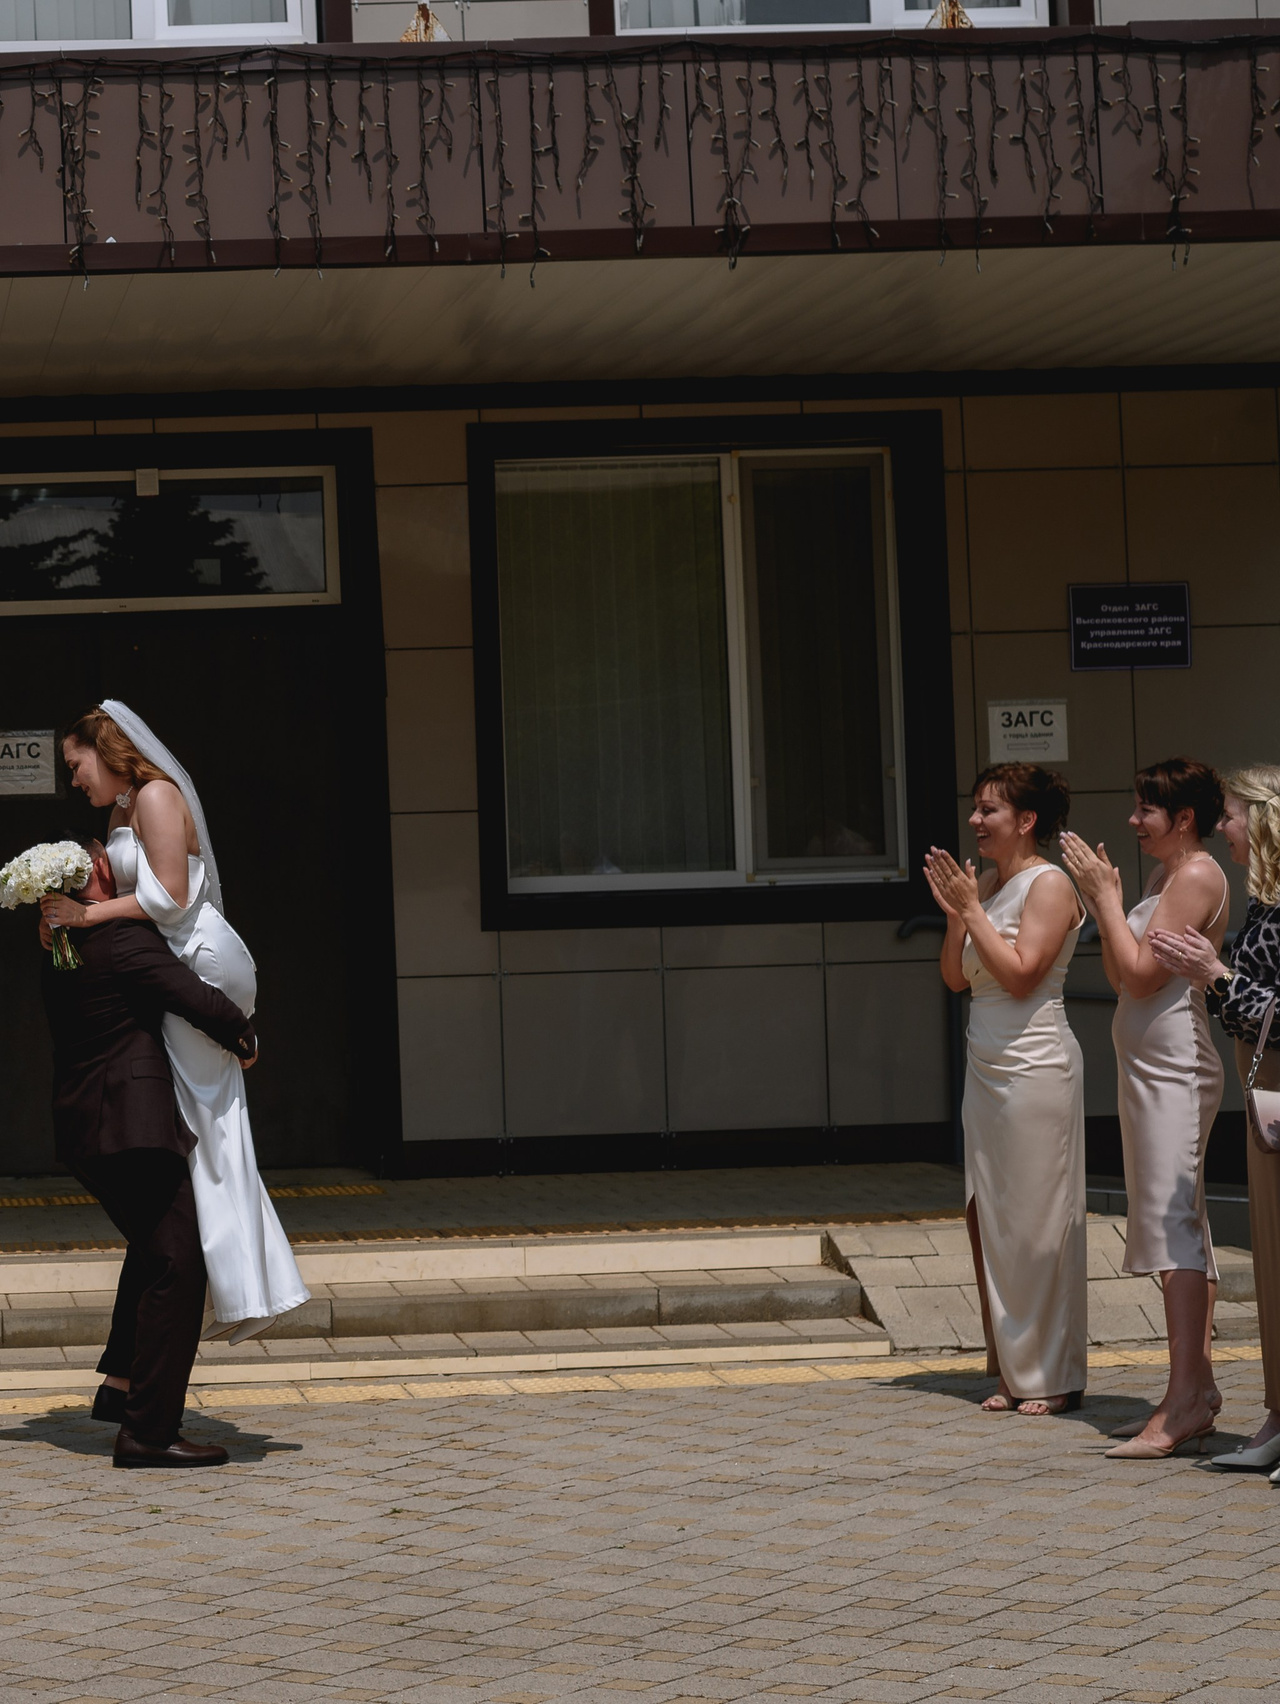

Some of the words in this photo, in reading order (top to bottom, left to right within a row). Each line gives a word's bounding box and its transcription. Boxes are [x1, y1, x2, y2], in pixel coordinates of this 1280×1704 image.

[1100, 604, 1130, 613] Отдел
[1135, 603, 1159, 611] ЗАГС
[1075, 616, 1149, 625] Выселковского
[1151, 615, 1185, 625] района
[1089, 629, 1146, 638] управление
[1148, 627, 1172, 635] ЗАГС
[1080, 640, 1158, 650] Краснодарского
[1160, 640, 1182, 648] края
[1001, 710, 1054, 727] ЗАГС
